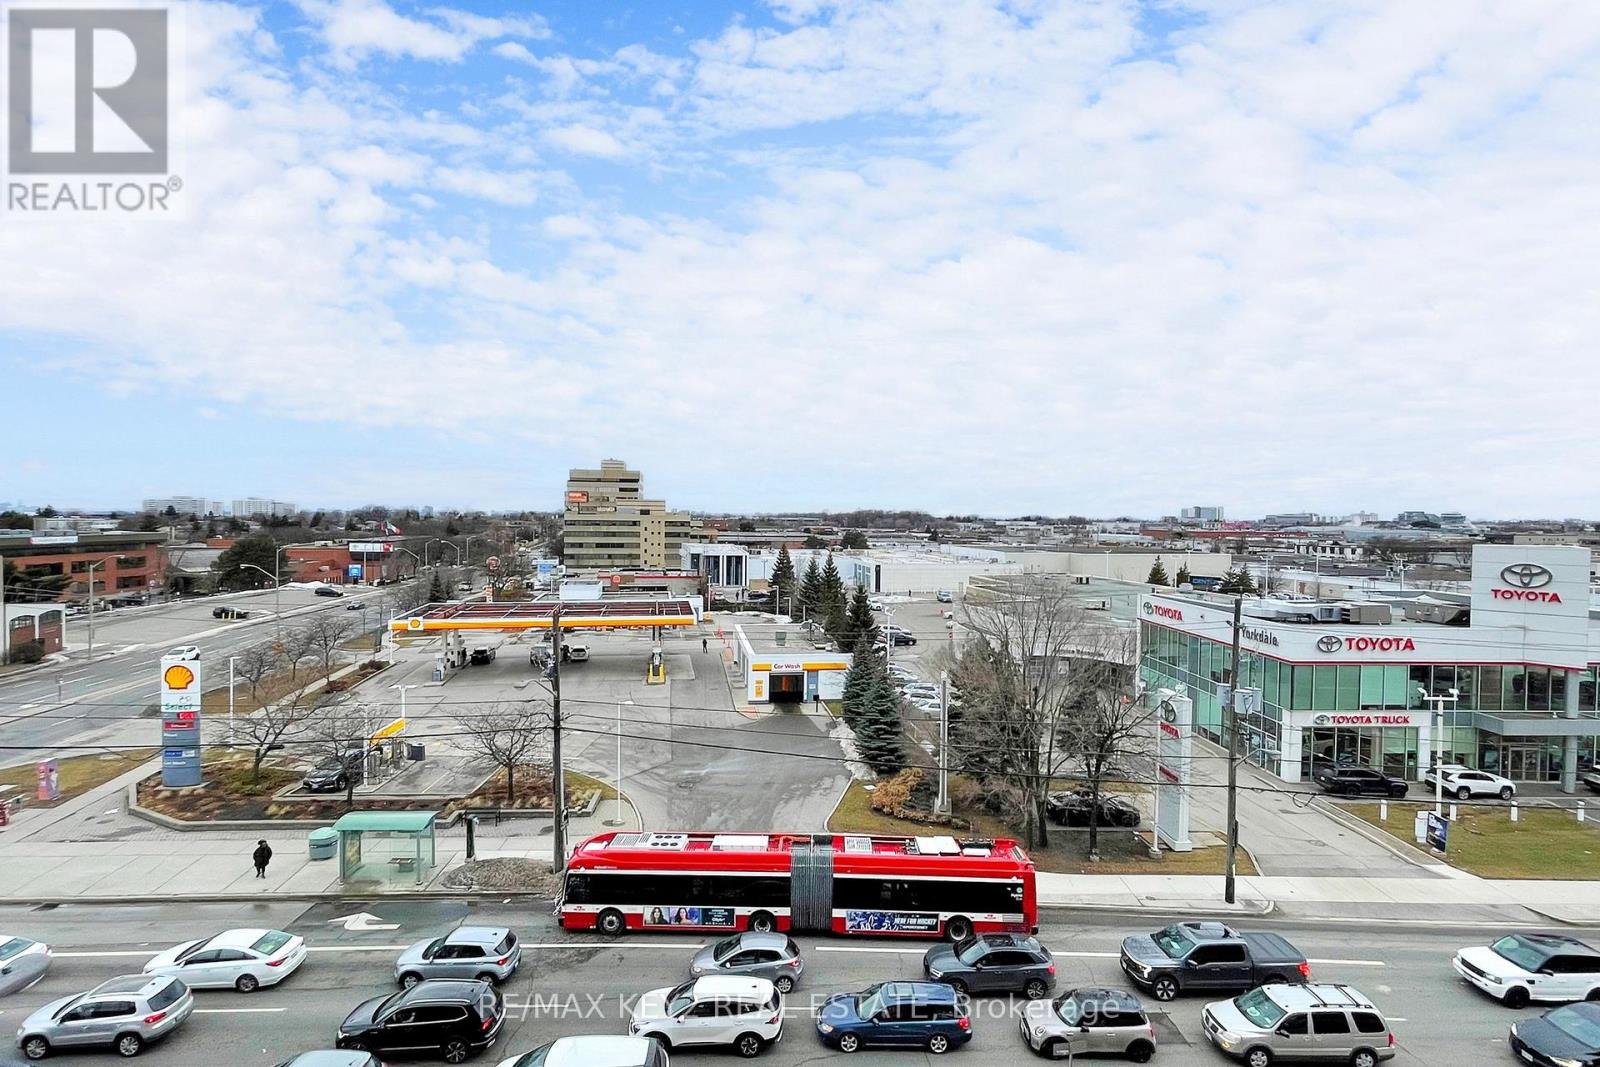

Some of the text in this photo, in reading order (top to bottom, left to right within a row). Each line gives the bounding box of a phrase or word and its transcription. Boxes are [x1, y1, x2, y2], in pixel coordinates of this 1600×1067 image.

[1490, 589, 1562, 604] TOYOTA
[1153, 605, 1183, 621] TOYOTA
[1240, 623, 1278, 646] Yorkdale
[1345, 637, 1416, 651] TOYOTA
[1330, 715, 1410, 724] TOYOTA TRUCK
